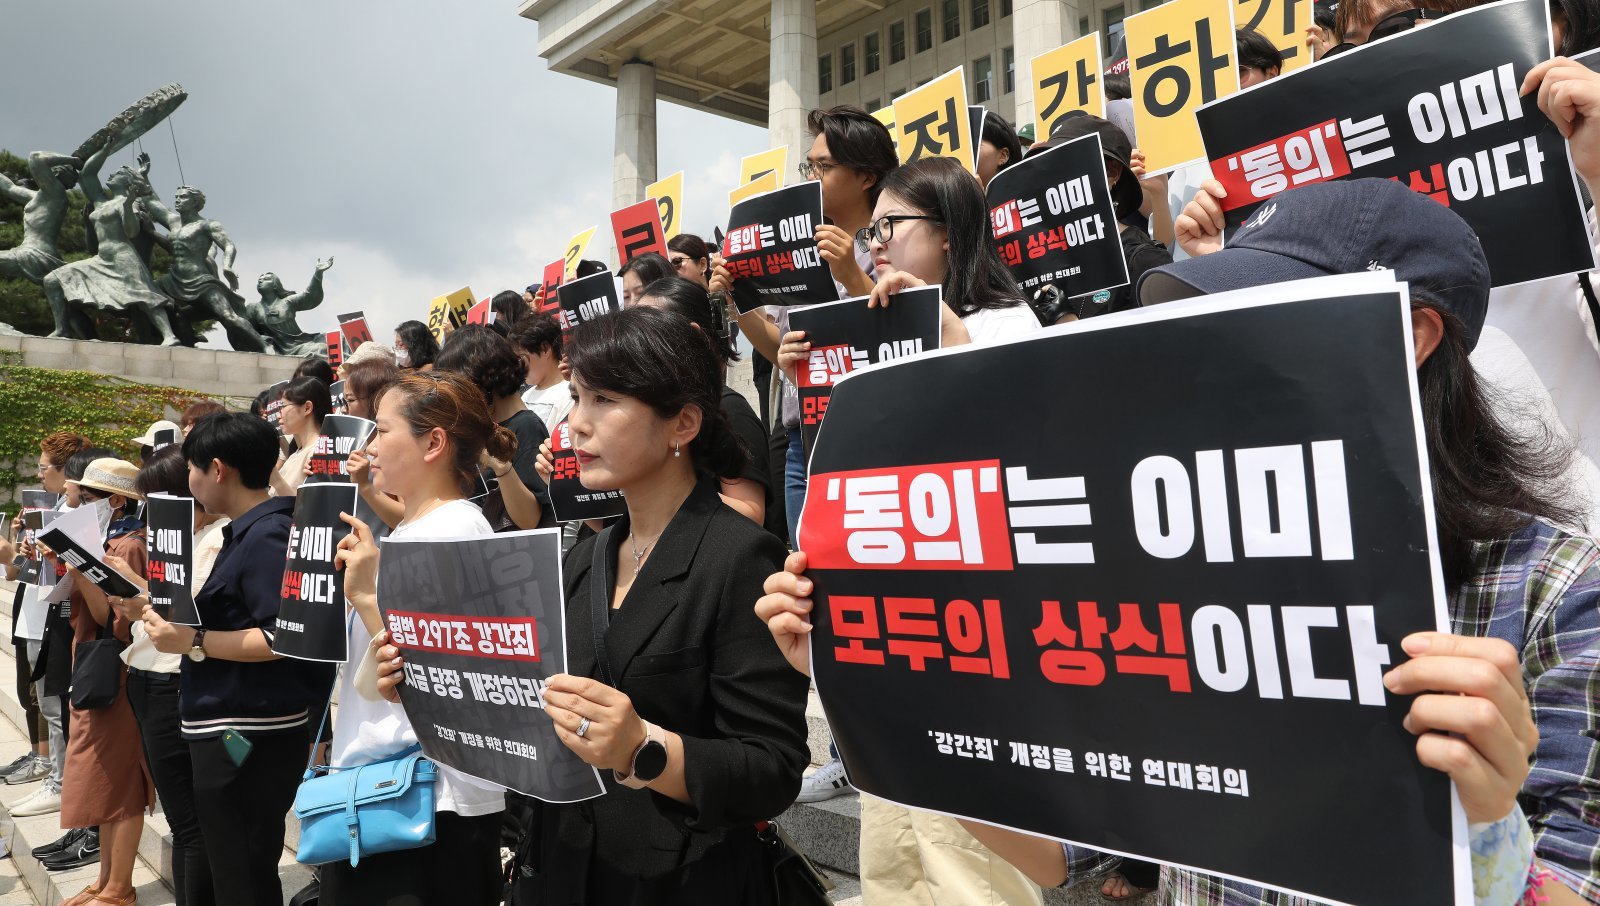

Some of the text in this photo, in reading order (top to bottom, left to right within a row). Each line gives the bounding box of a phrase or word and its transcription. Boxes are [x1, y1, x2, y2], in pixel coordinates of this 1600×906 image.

[1135, 17, 1230, 117] 하
[1228, 63, 1524, 198] '동의'는 이미
[1391, 135, 1545, 208] 식이다
[990, 174, 1095, 238] 의'는 이미
[728, 213, 812, 254] '동의'는 이미
[1026, 213, 1105, 259] 상식이다
[766, 245, 822, 273] 상식이다
[827, 439, 1355, 565] '동의'는 이미
[157, 528, 182, 556] 이미
[301, 526, 333, 562] 이미
[388, 613, 536, 657] 형법 297조 강간죄
[828, 595, 1391, 707] 모두의 상식이다
[403, 660, 430, 693] 지금
[428, 665, 464, 700] 당장
[433, 723, 537, 761] '강간죄' 개정을 위한 연대회의
[928, 730, 1250, 798] '강간죄' 개정을 위한 연대회의
